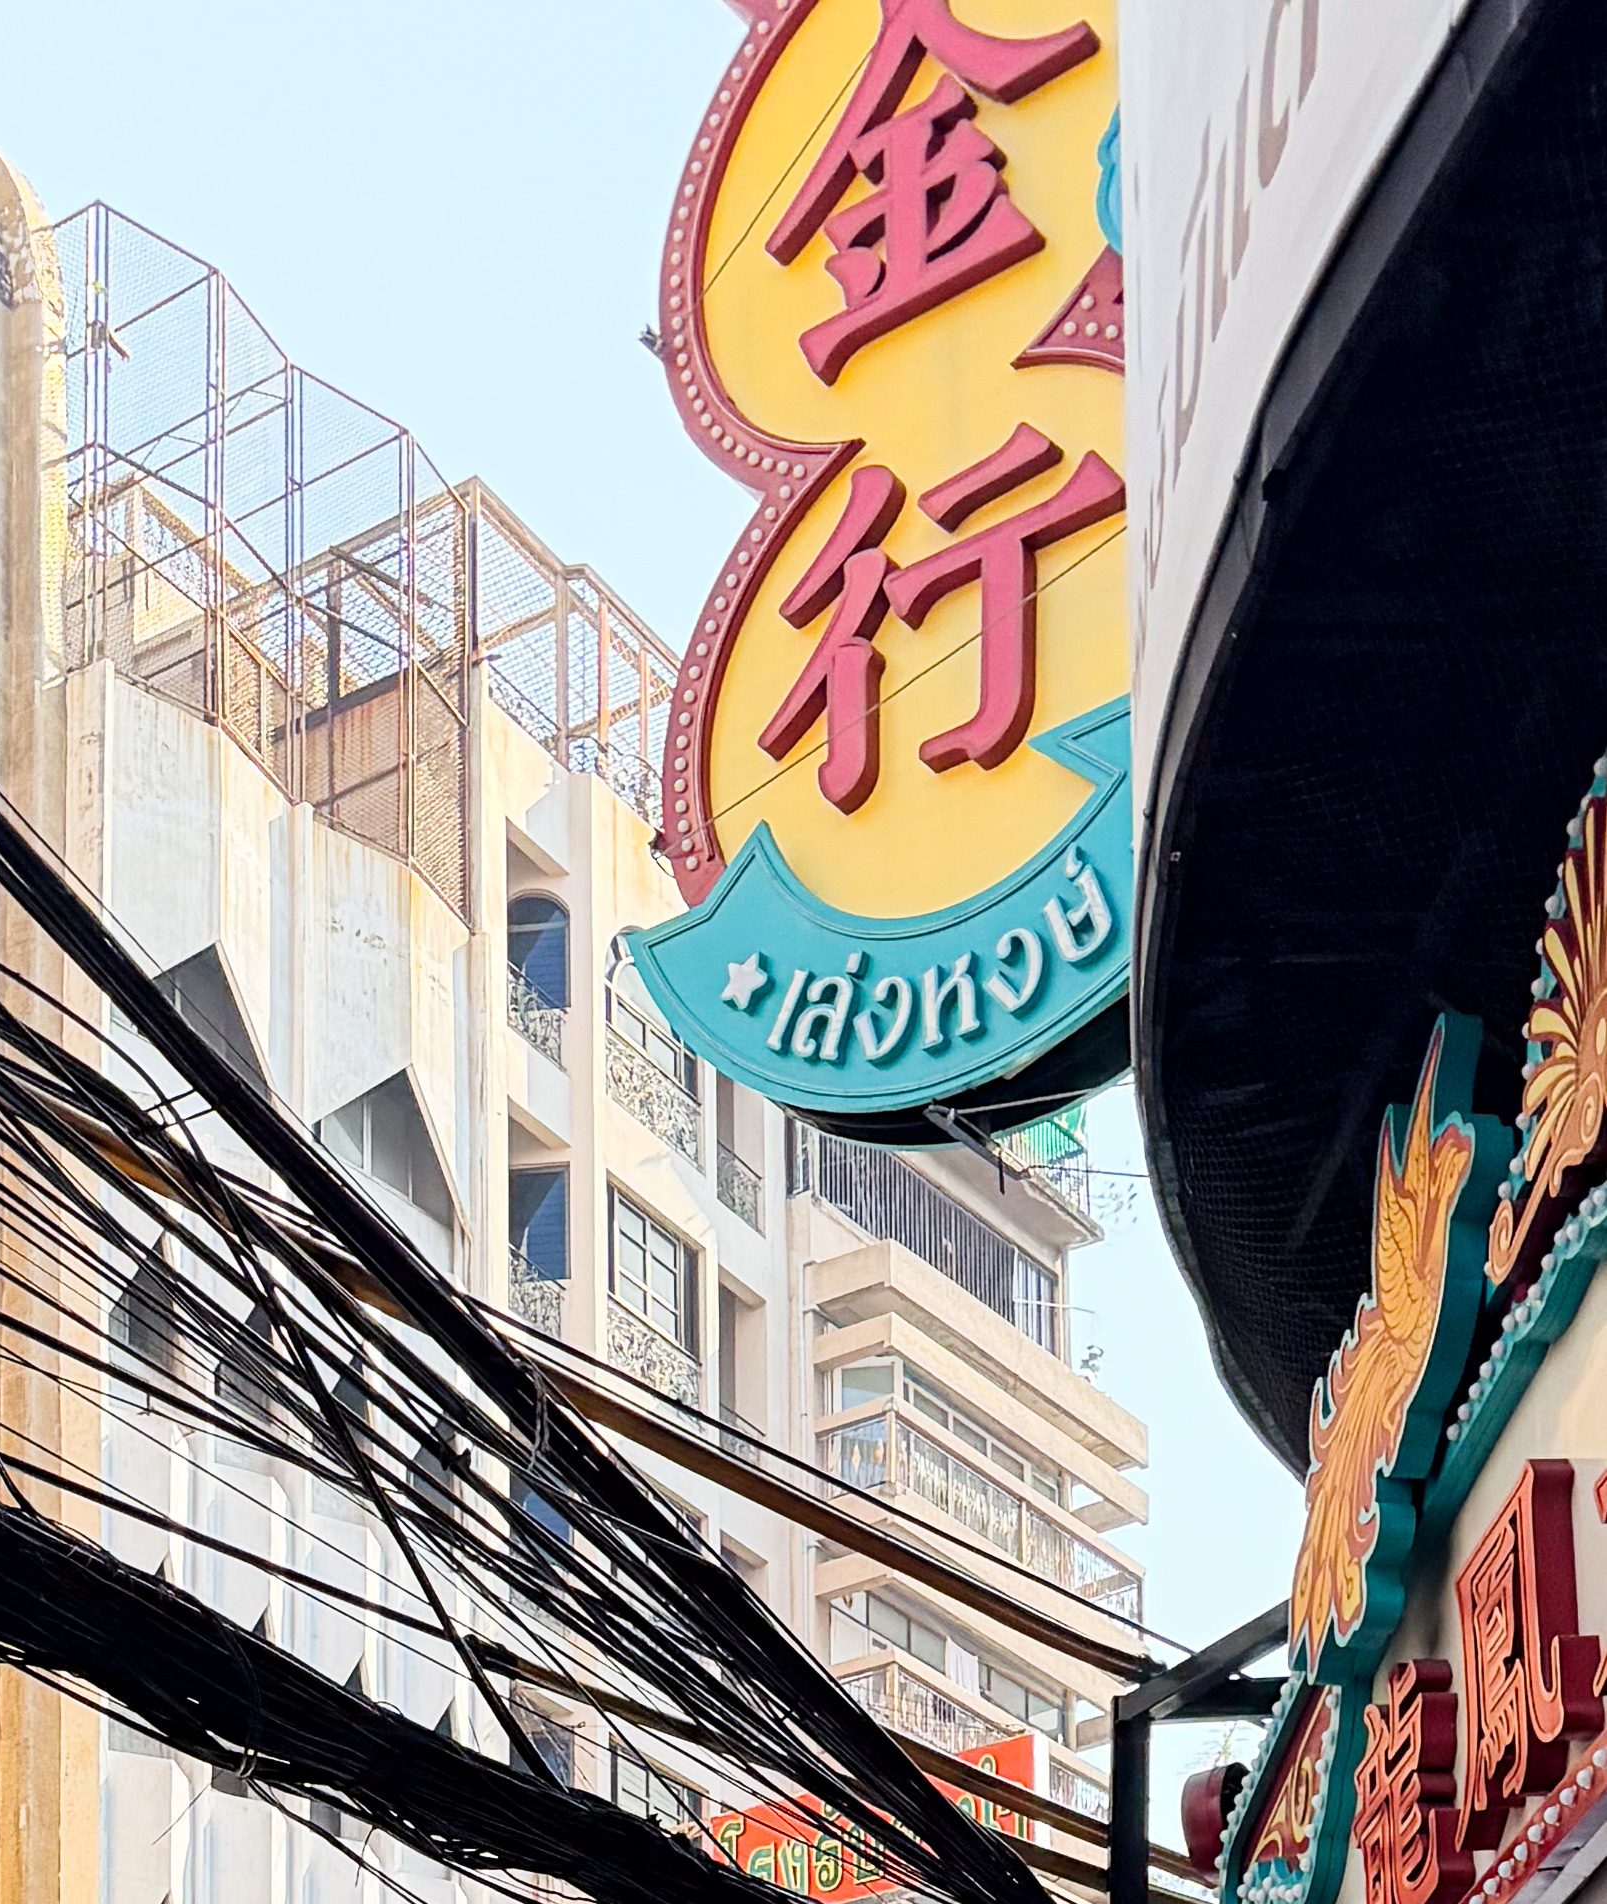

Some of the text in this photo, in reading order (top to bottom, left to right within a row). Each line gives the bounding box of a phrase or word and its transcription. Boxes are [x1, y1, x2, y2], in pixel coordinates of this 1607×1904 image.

[758, 0, 1125, 816] 金行
[766, 842, 1113, 1063] เล่งหงษ์
